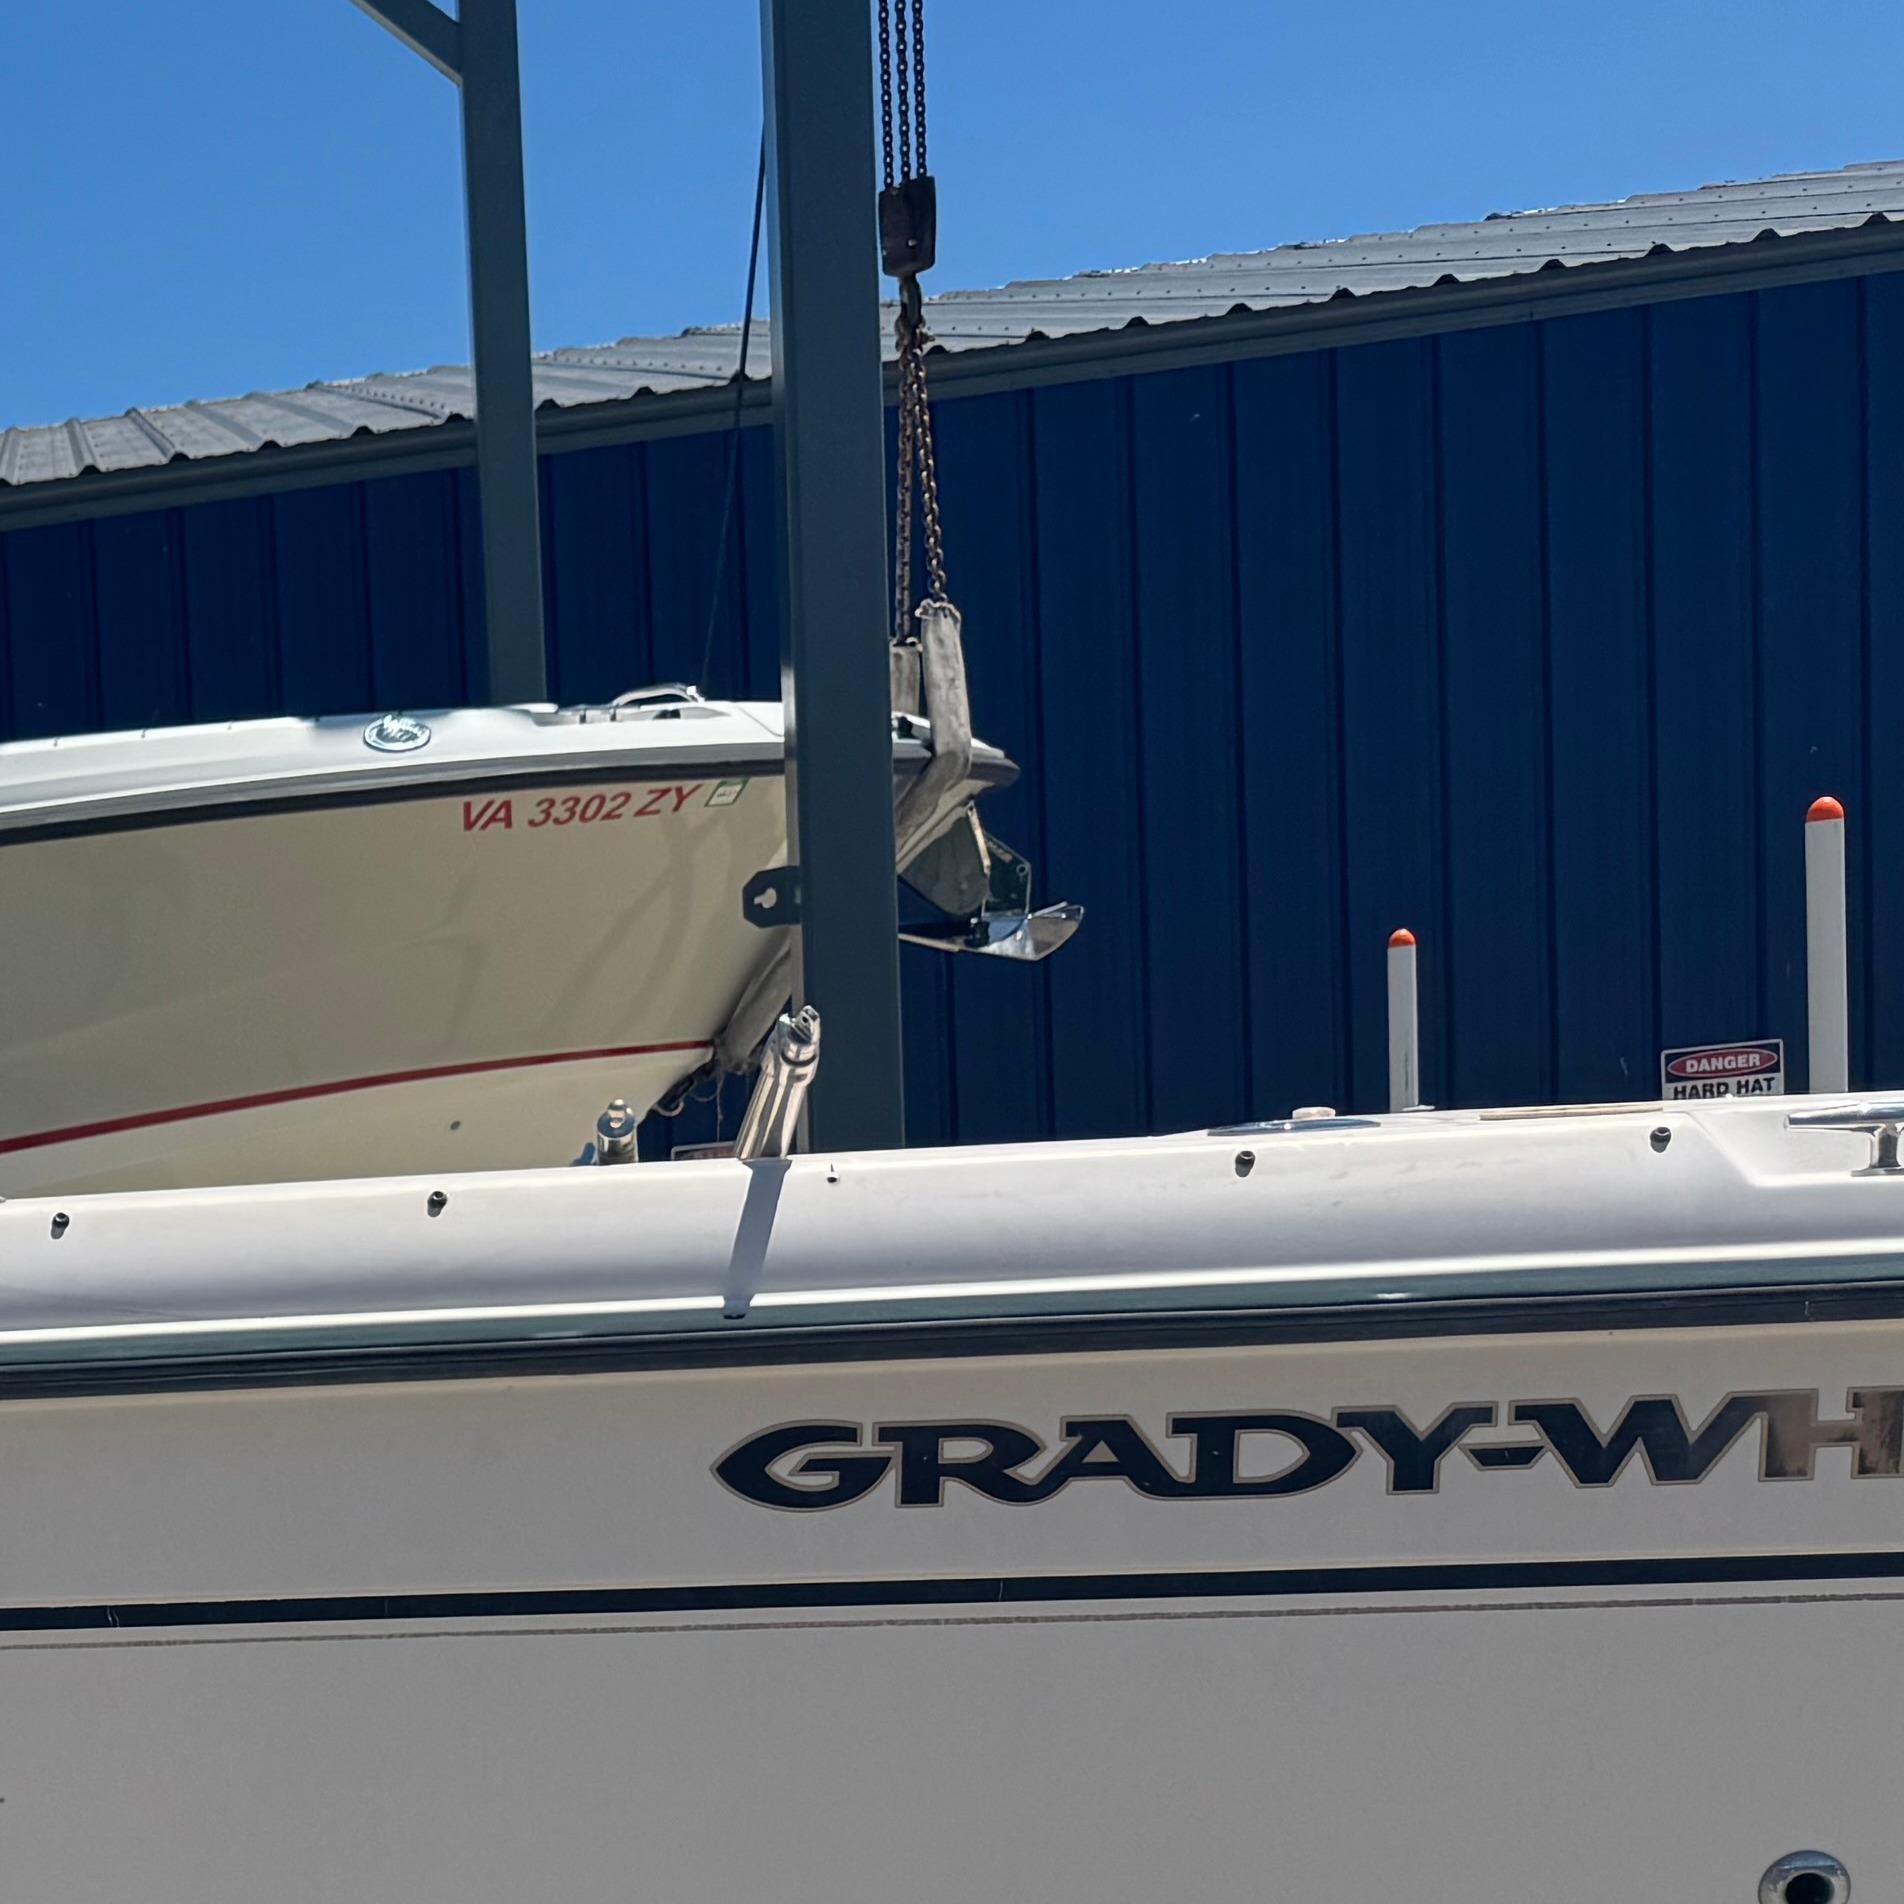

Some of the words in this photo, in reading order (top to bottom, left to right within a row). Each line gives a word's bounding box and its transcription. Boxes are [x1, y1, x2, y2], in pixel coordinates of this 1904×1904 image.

[462, 799, 512, 832] VA
[527, 791, 631, 828] 3302
[632, 783, 703, 818] ZY
[1685, 1053, 1761, 1075] DANGER
[1673, 1080, 1729, 1101] HARD
[1736, 1077, 1776, 1095] HAT
